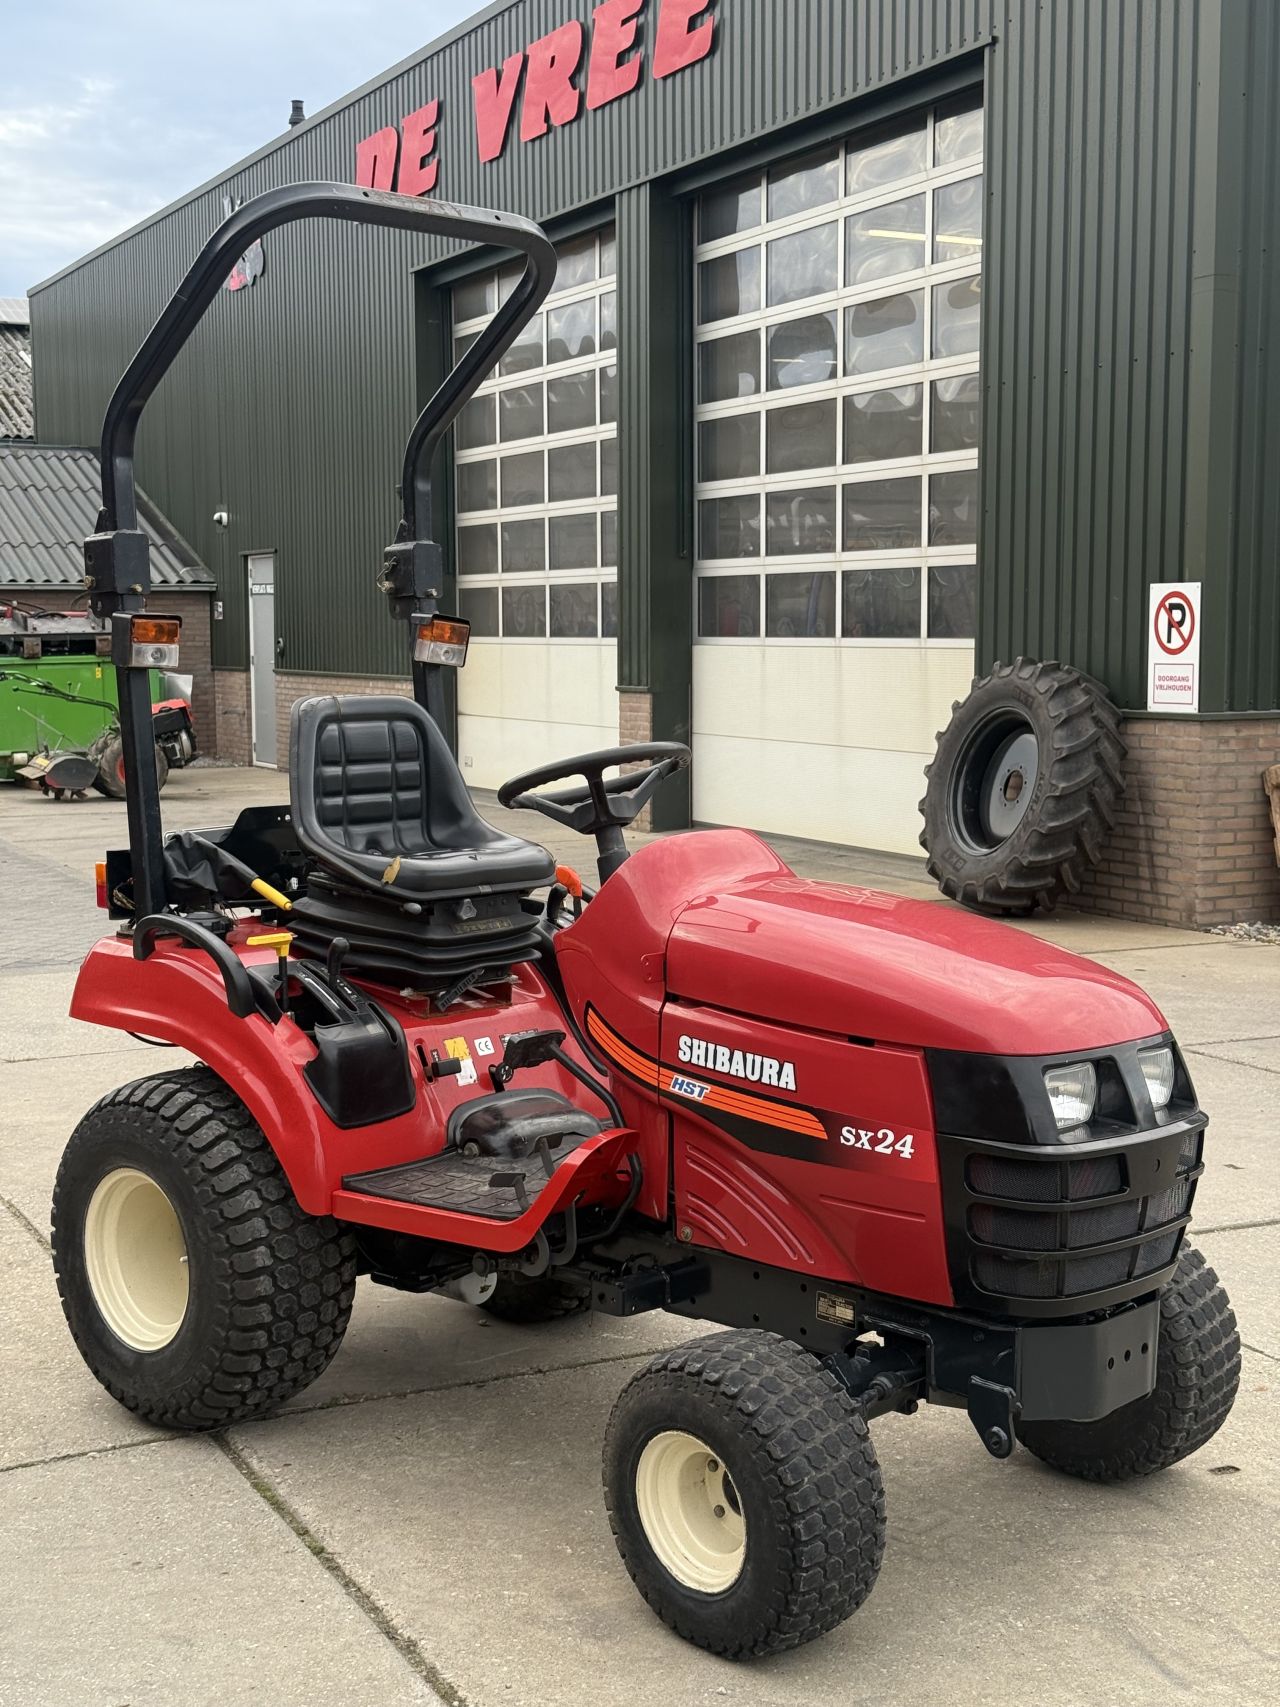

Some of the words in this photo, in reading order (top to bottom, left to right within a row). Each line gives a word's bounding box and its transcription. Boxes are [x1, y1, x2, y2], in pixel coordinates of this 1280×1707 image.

[356, 97, 439, 197] DE
[471, 0, 714, 163] VREE
[1158, 675, 1189, 683] DOORGANG
[678, 1034, 797, 1092] SHIBAURA
[671, 1076, 710, 1099] HST
[840, 1126, 915, 1159] SX24
